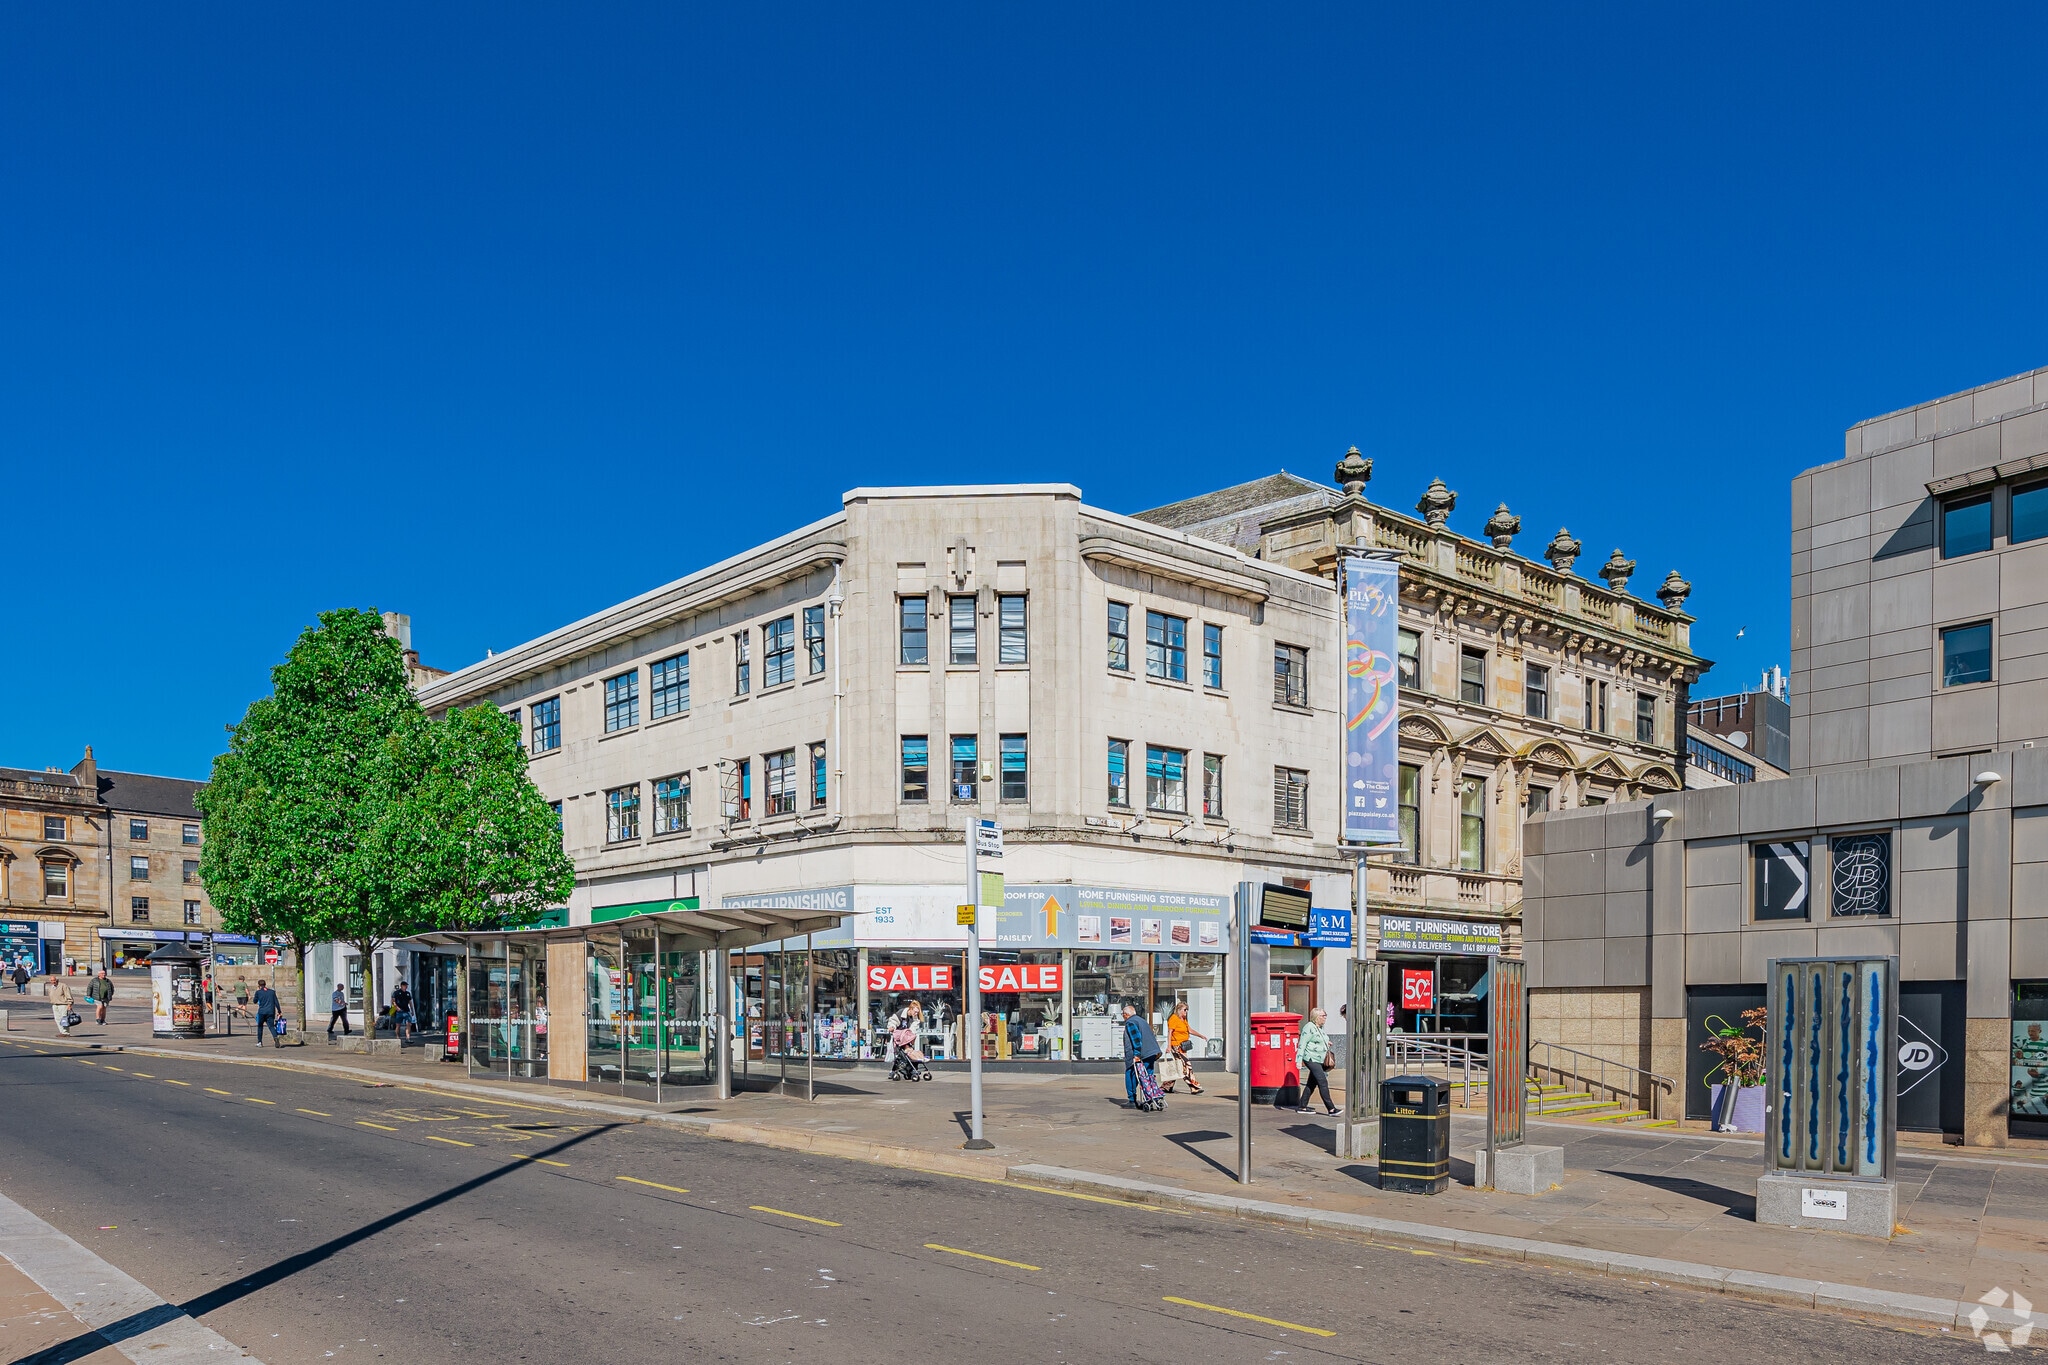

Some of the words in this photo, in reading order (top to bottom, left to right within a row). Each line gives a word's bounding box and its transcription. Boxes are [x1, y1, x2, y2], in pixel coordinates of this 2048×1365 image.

[977, 839, 987, 847] Bus
[988, 841, 1000, 849] Stop
[1078, 890, 1105, 899] HOME
[1105, 891, 1156, 903] FURNISHING
[1159, 895, 1186, 905] STORE
[1189, 897, 1220, 906] PAISLEY
[1107, 902, 1132, 910] DINING
[1320, 916, 1329, 928] &
[1330, 915, 1346, 929] M
[1383, 919, 1411, 931] HOME
[1415, 921, 1469, 935] FURNISHING
[1472, 924, 1500, 937] STORE
[998, 934, 1033, 942] PAISLEY
[1384, 931, 1401, 939] LIGHTS
[1421, 933, 1443, 941] PICTURES
[1465, 935, 1475, 943] AND
[1383, 939, 1411, 949] BOOKING
[1412, 941, 1417, 949] &
[1418, 941, 1452, 951] DELIVERIES
[1462, 943, 1475, 952] 0141
[1476, 944, 1486, 953] 889
[1486, 945, 1500, 953] 6092
[869, 966, 950, 991] SALE
[978, 966, 1058, 991] SALE
[1903, 1048, 1930, 1063] JD
[1395, 1107, 1417, 1115] Litter
